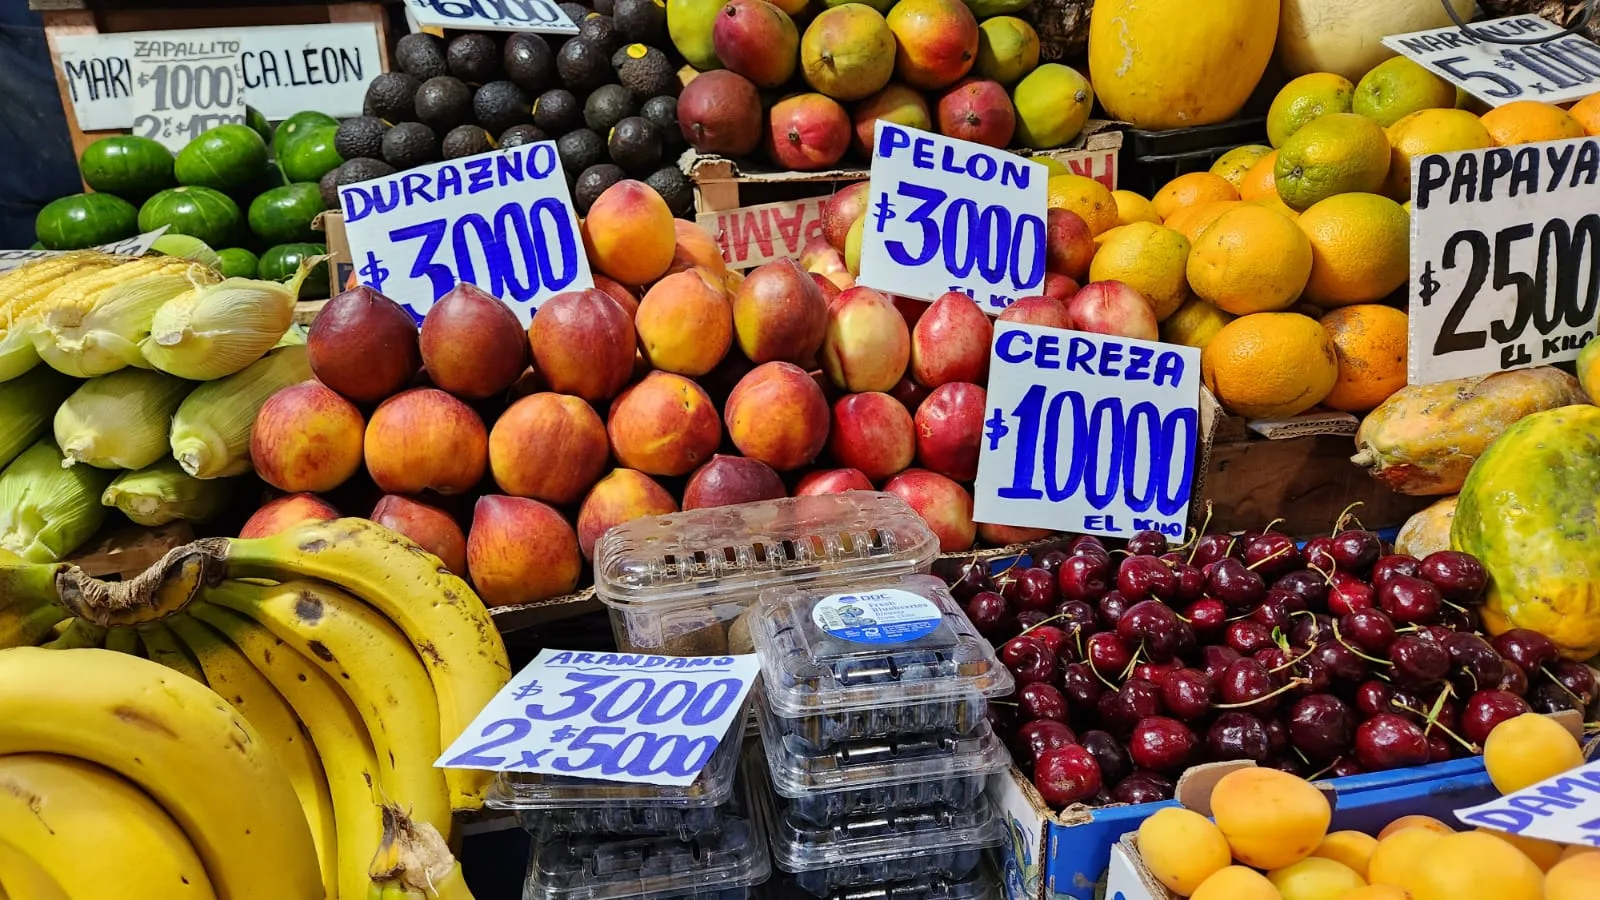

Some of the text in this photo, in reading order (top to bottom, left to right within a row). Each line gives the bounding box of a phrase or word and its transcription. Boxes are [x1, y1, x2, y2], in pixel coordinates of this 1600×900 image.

[134, 40, 240, 57] ZAPALLITO
[1398, 18, 1548, 54] NARANJA
[137, 64, 233, 111] $1000
[341, 144, 556, 223] DURAZNO
[878, 126, 1031, 189] PELON
[1416, 140, 1600, 209] PAPAYA
[359, 197, 578, 327] $3000
[873, 181, 1046, 289] $3000
[1419, 214, 1600, 355] $2500
[995, 330, 1185, 388] CEREZA
[1501, 344, 1532, 369] EL
[985, 384, 1197, 516] $10000
[1084, 515, 1182, 537] EL KILO
[545, 652, 734, 668] ARANDANO
[512, 672, 743, 726] $3000
